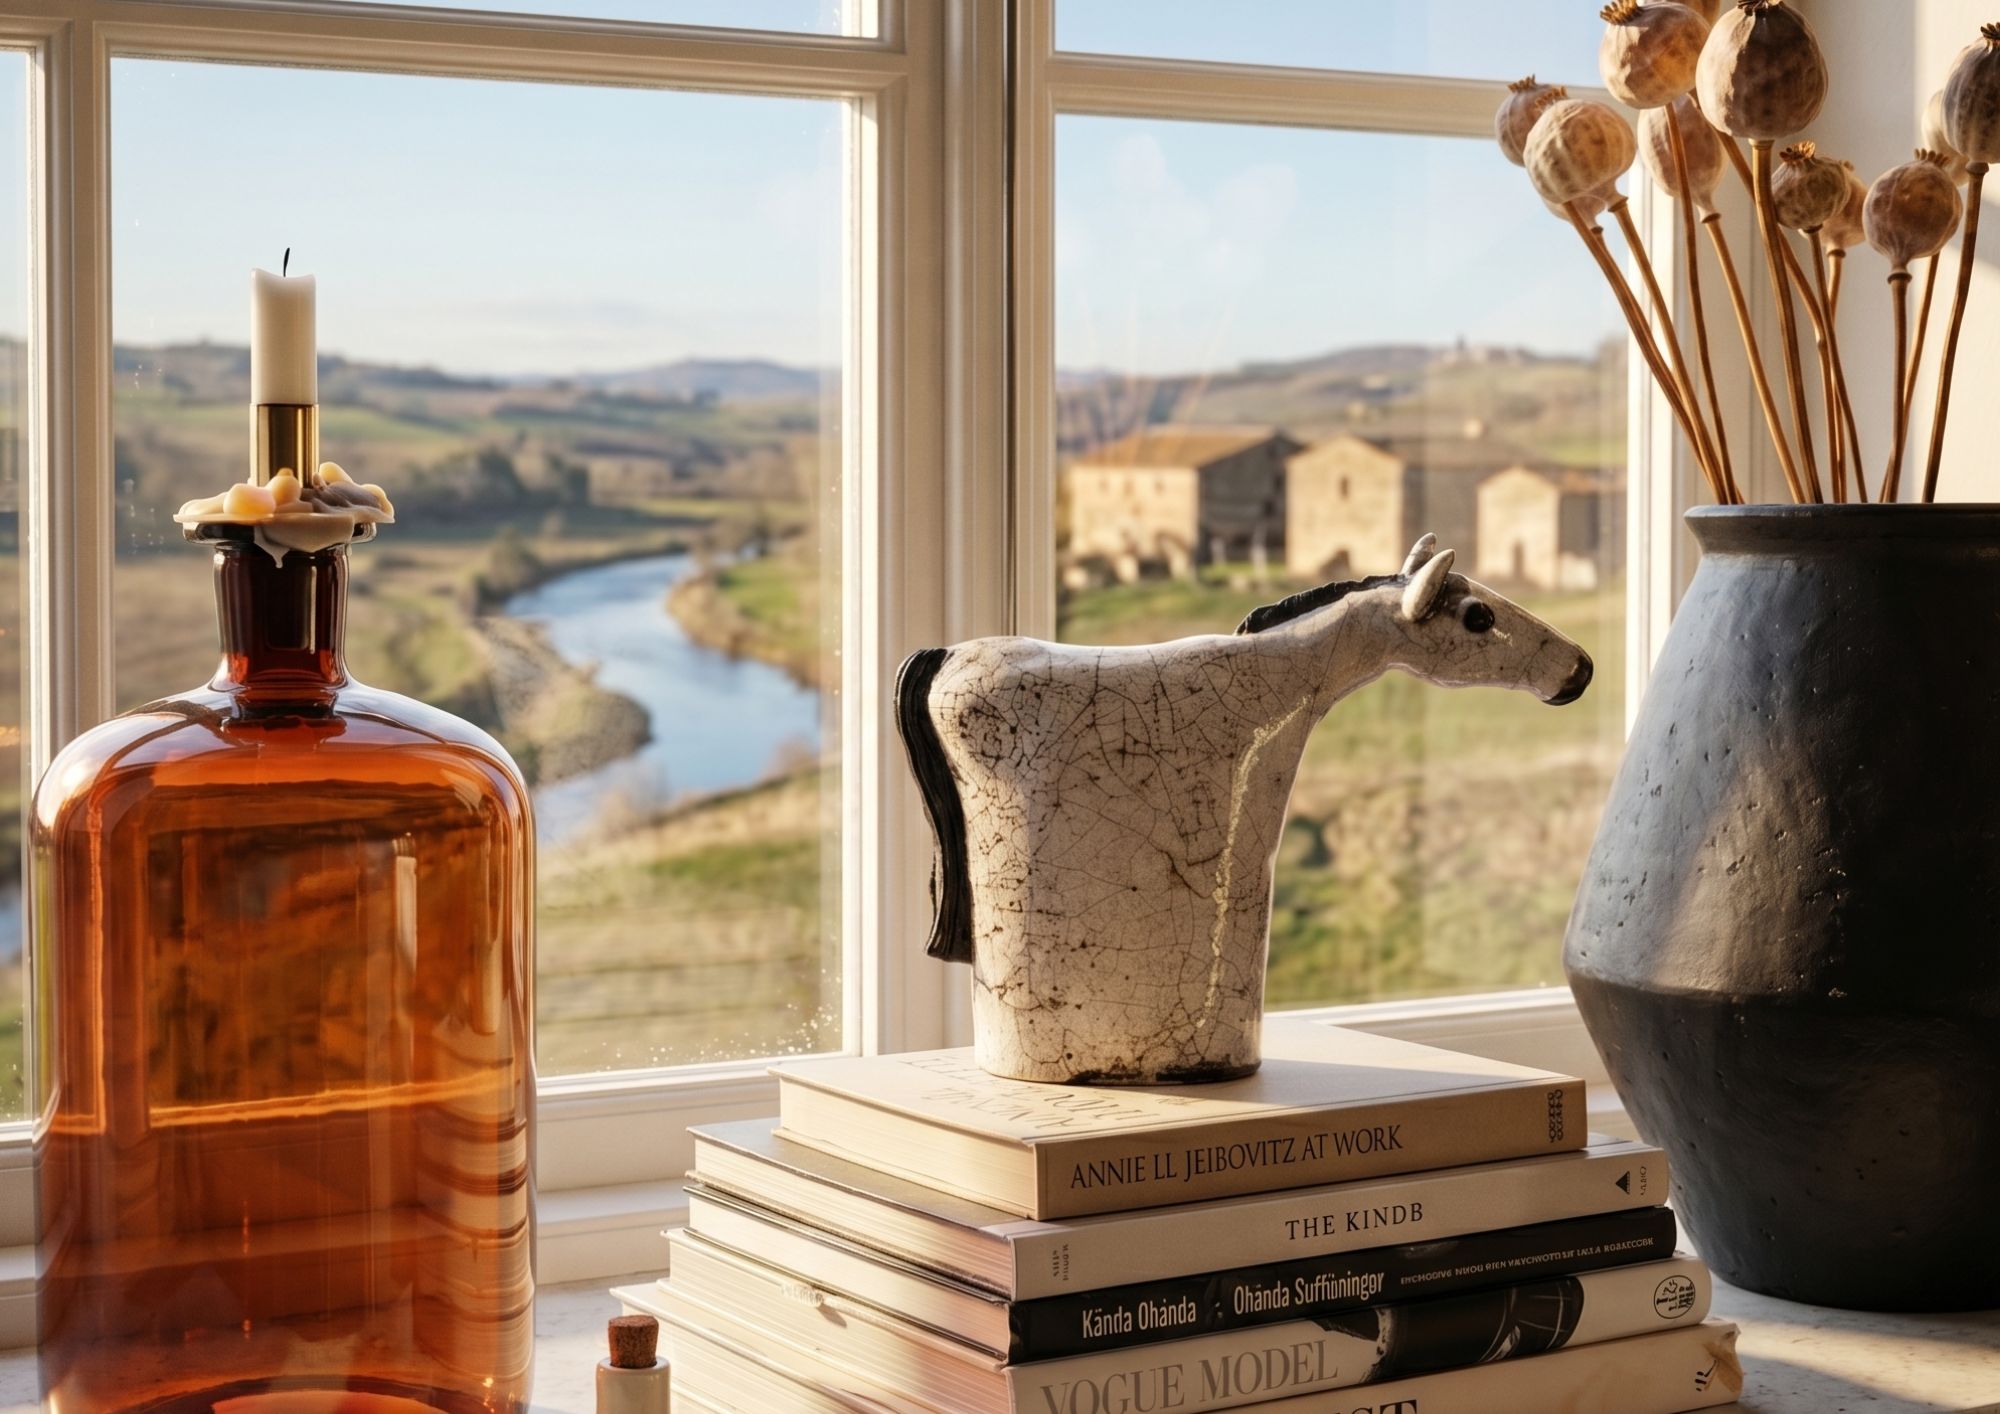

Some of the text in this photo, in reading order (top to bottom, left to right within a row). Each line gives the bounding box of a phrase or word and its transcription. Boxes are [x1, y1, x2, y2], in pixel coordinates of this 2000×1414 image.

[1070, 1124, 1403, 1189] ANNIE LL JEIBOVITZ AT WORK
[1285, 1202, 1423, 1240] THE KINDB
[1082, 1305, 1133, 1339] Kända
[1040, 1339, 1338, 1414] VOGUE MODEL
